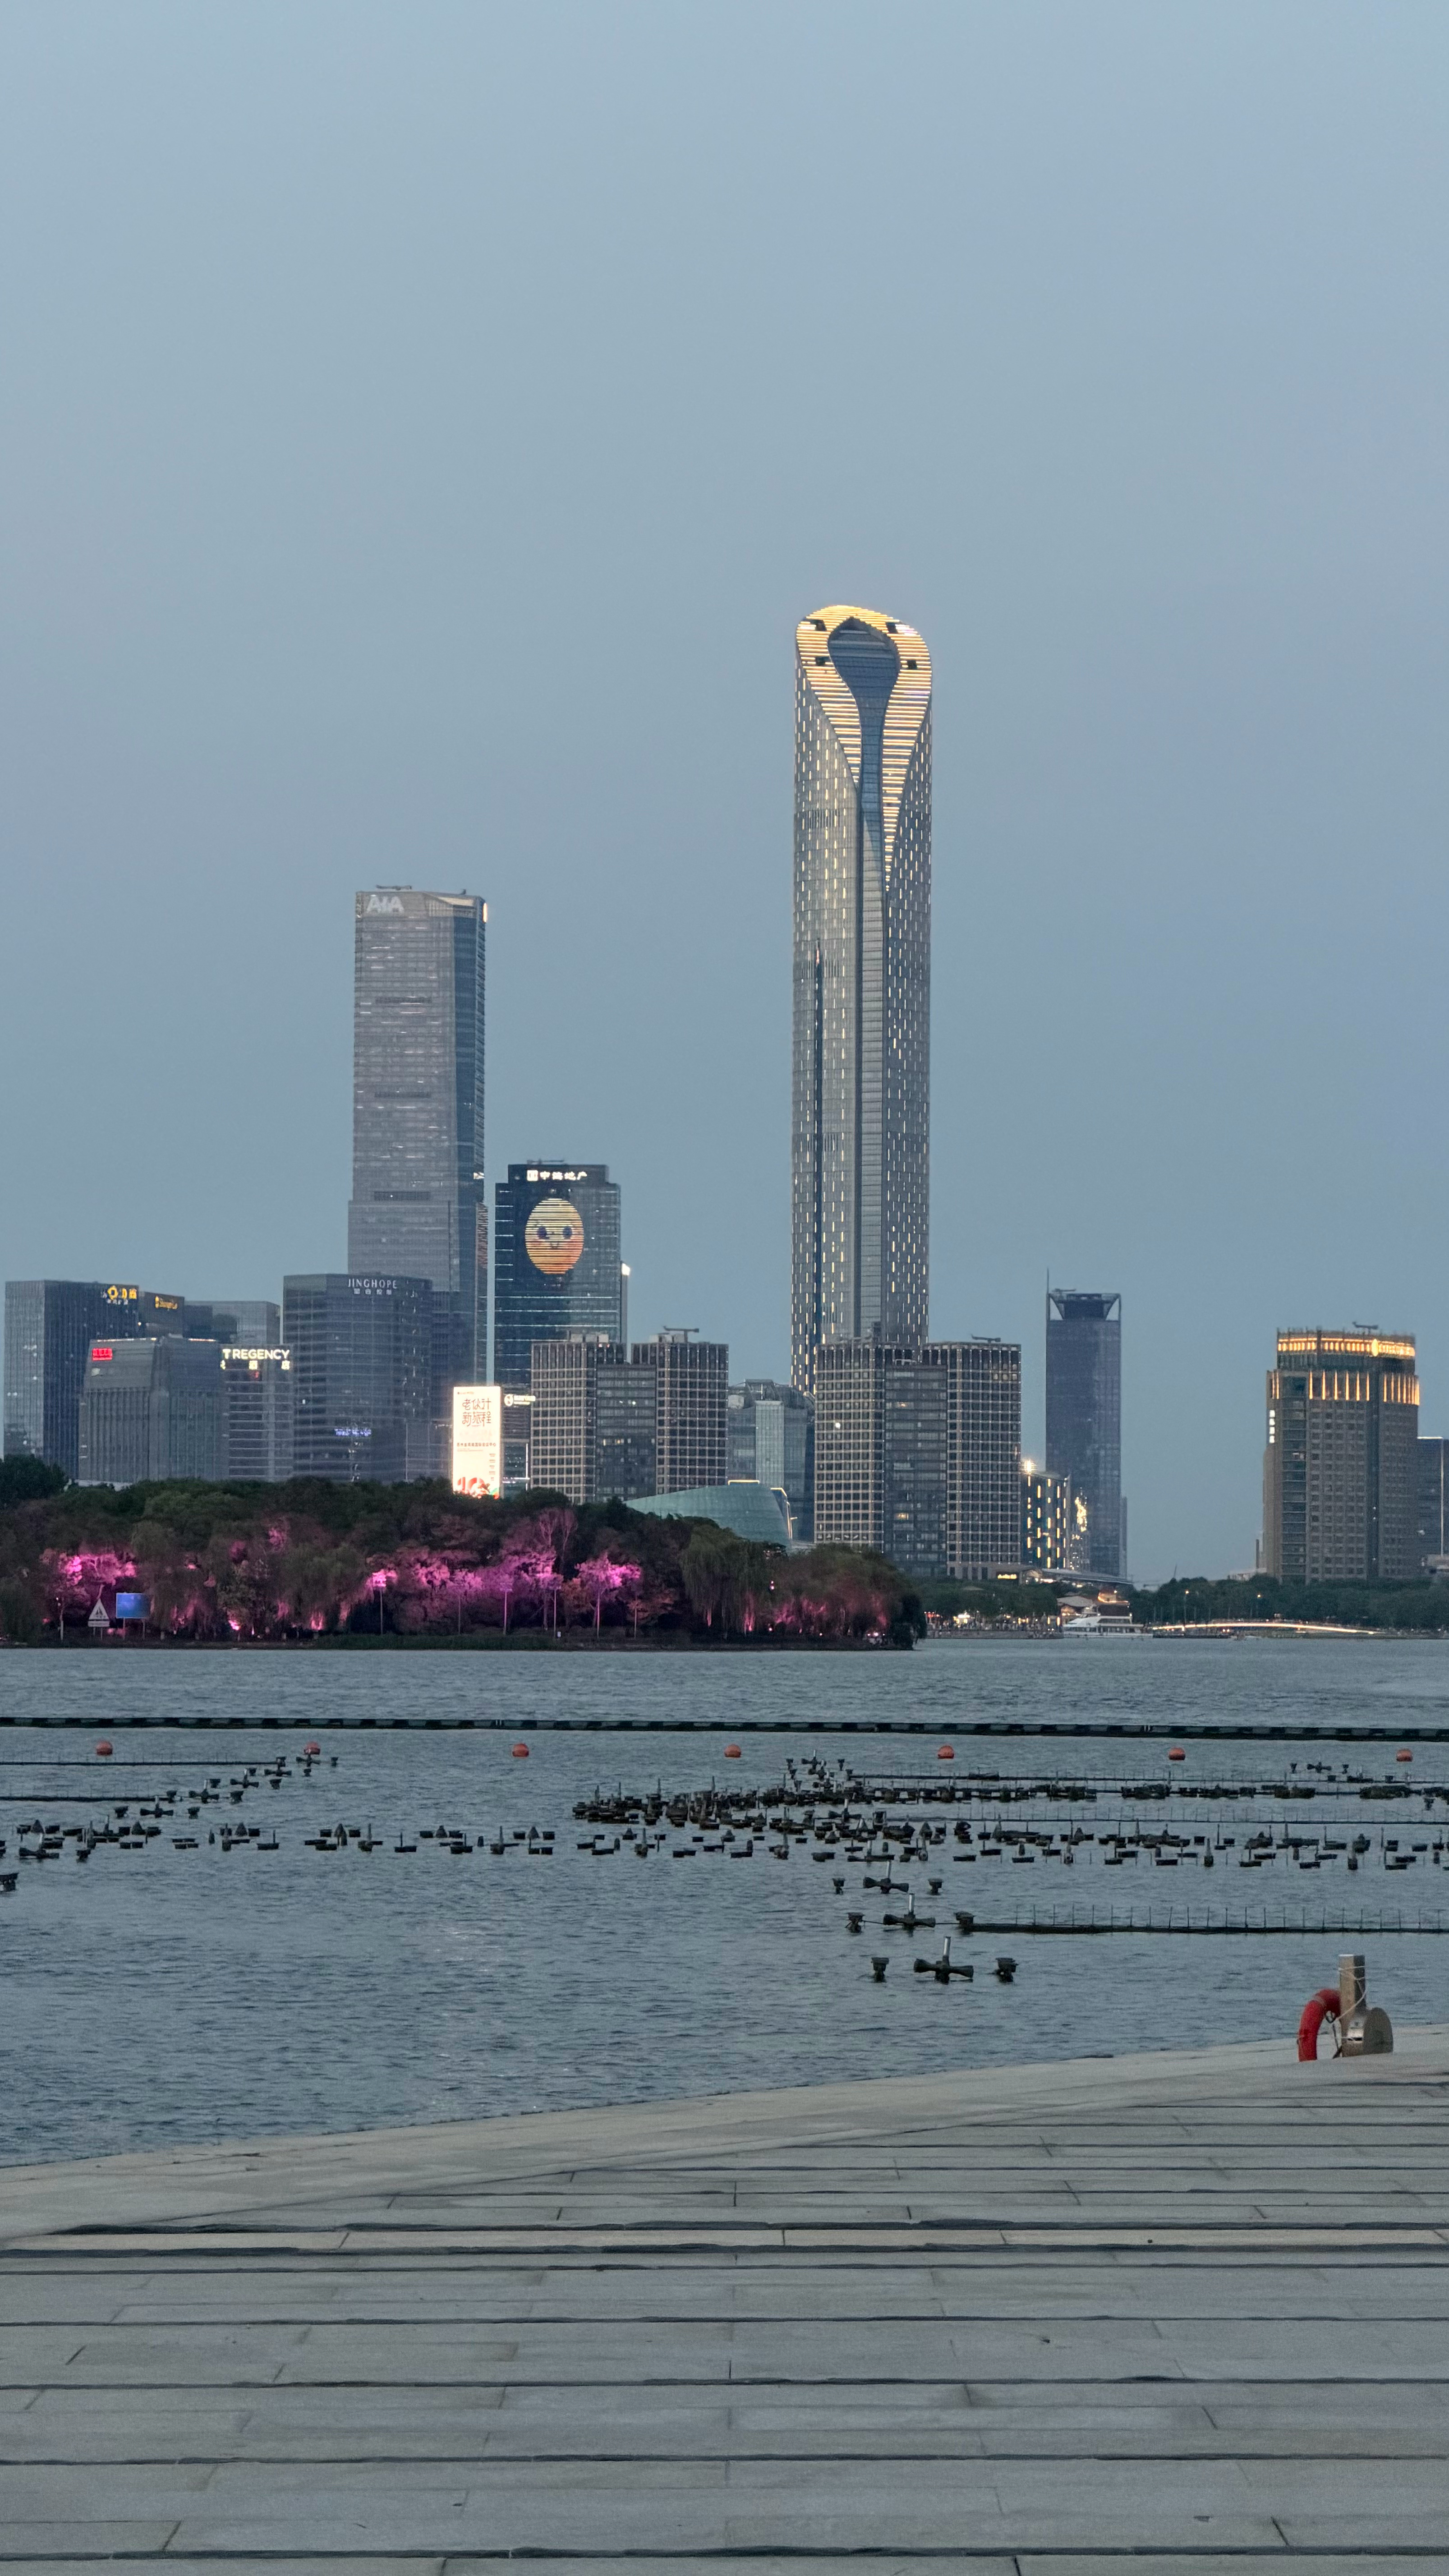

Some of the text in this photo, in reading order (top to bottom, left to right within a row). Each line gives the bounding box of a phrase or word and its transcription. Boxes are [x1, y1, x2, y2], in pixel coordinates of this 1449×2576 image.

[348, 1278, 397, 1289] JINGHOPE
[232, 1348, 290, 1360] REGENCY
[462, 1398, 492, 1410] 老伙计
[462, 1411, 492, 1426] 新旅程
